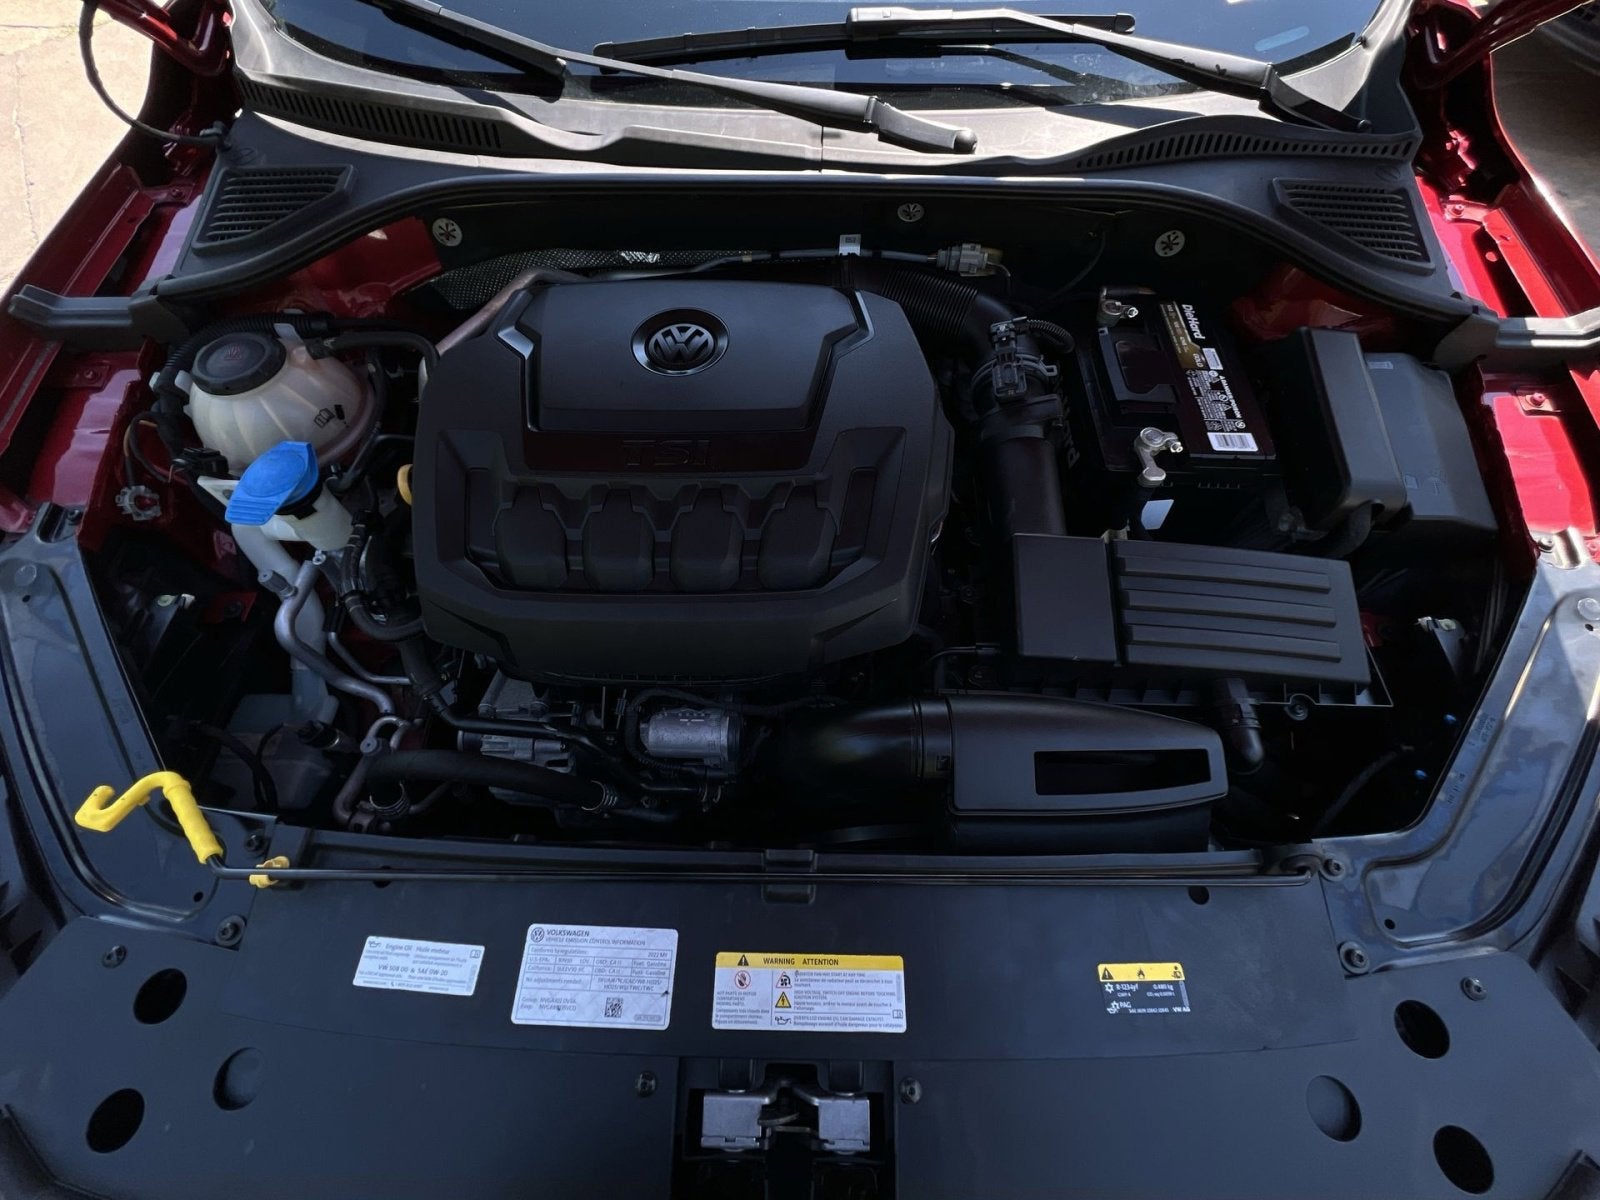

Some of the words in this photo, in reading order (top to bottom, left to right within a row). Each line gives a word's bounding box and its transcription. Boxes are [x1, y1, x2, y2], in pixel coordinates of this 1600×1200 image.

[1182, 304, 1205, 339] DieHard
[1192, 353, 1204, 368] GOLD
[622, 440, 710, 466] TSI
[802, 958, 838, 966] ATTENTION
